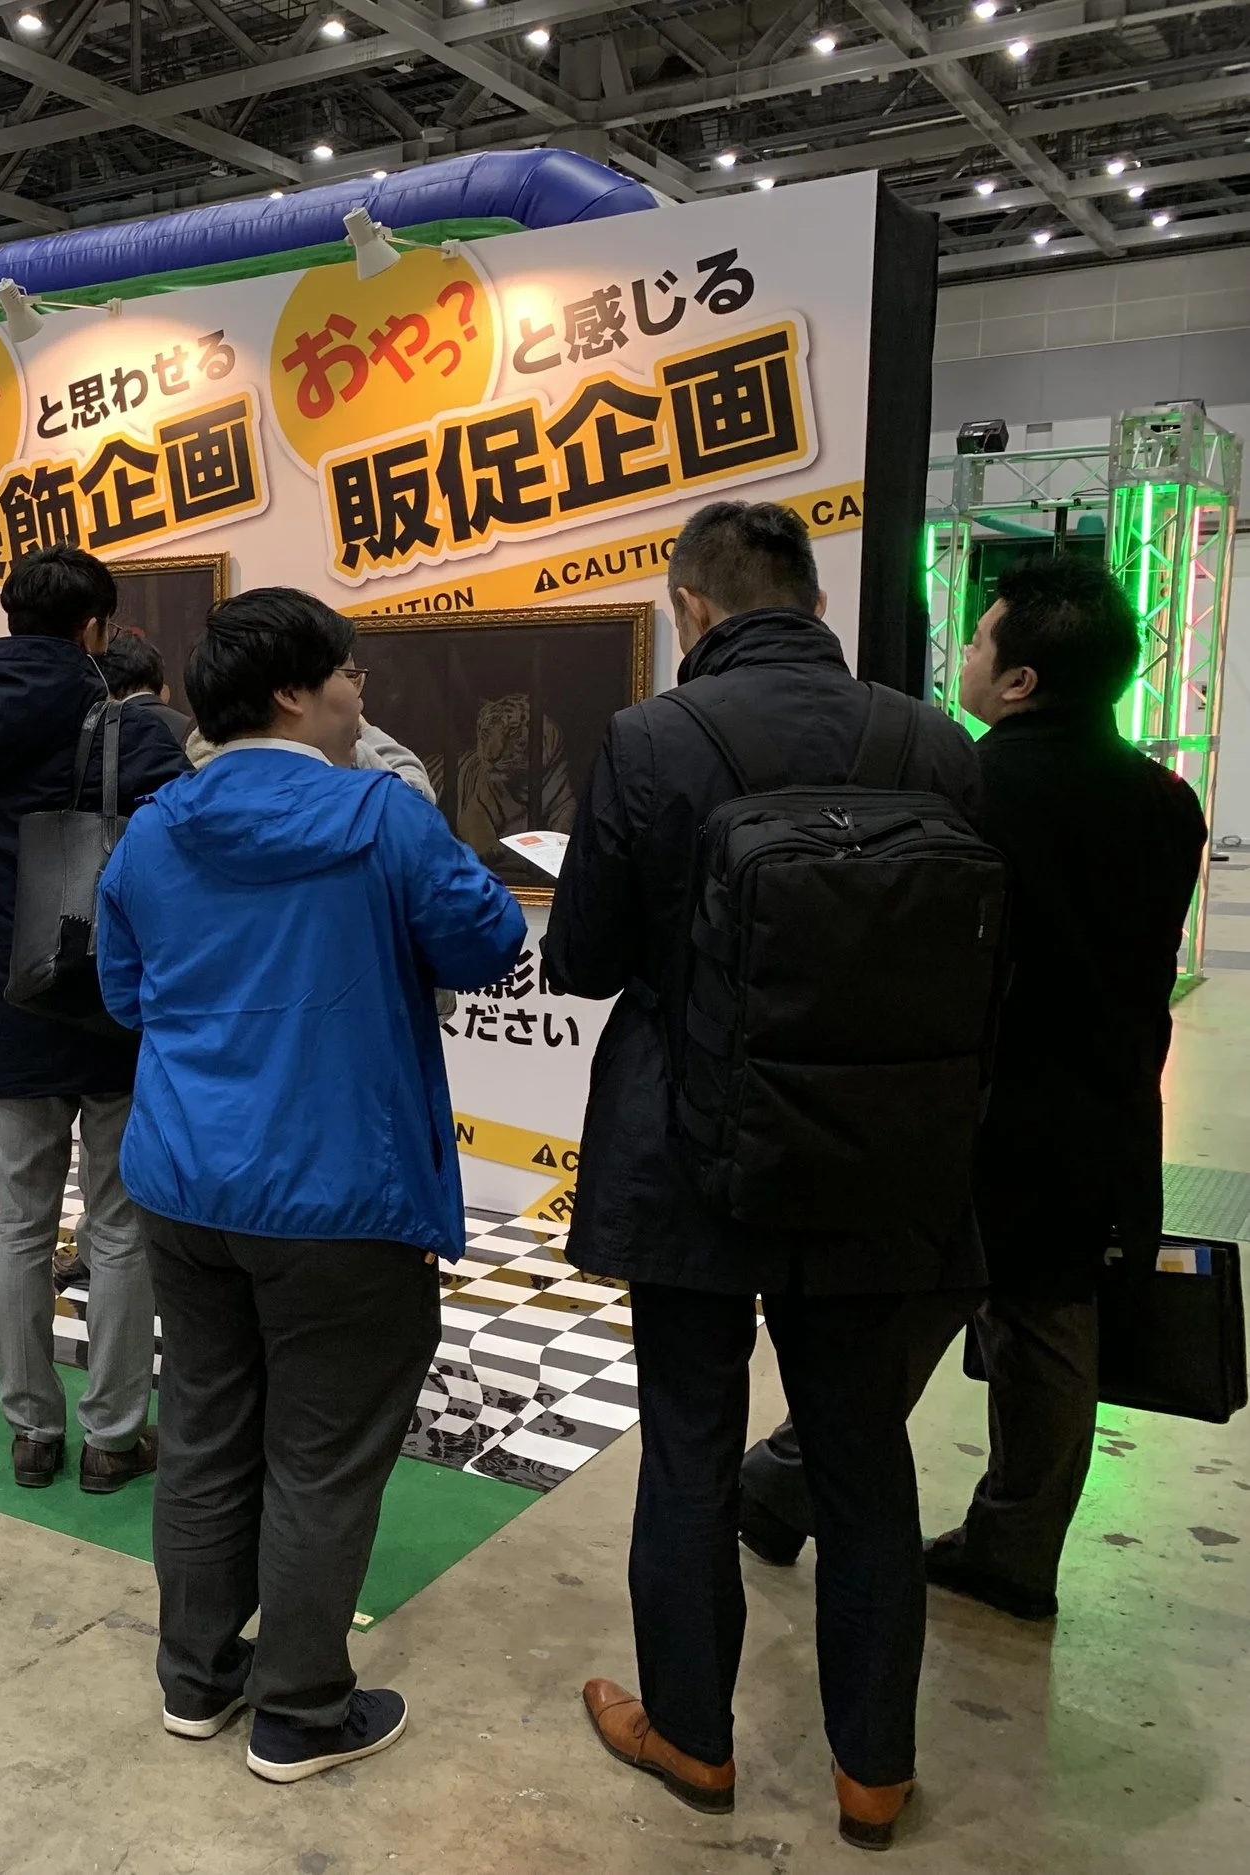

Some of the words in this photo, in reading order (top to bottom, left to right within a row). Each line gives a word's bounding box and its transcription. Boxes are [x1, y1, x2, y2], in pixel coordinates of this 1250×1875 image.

[512, 248, 756, 374] と感じる
[36, 330, 236, 439] と思わせる
[332, 330, 799, 570] 販促企画
[562, 537, 678, 585] CAUTIO
